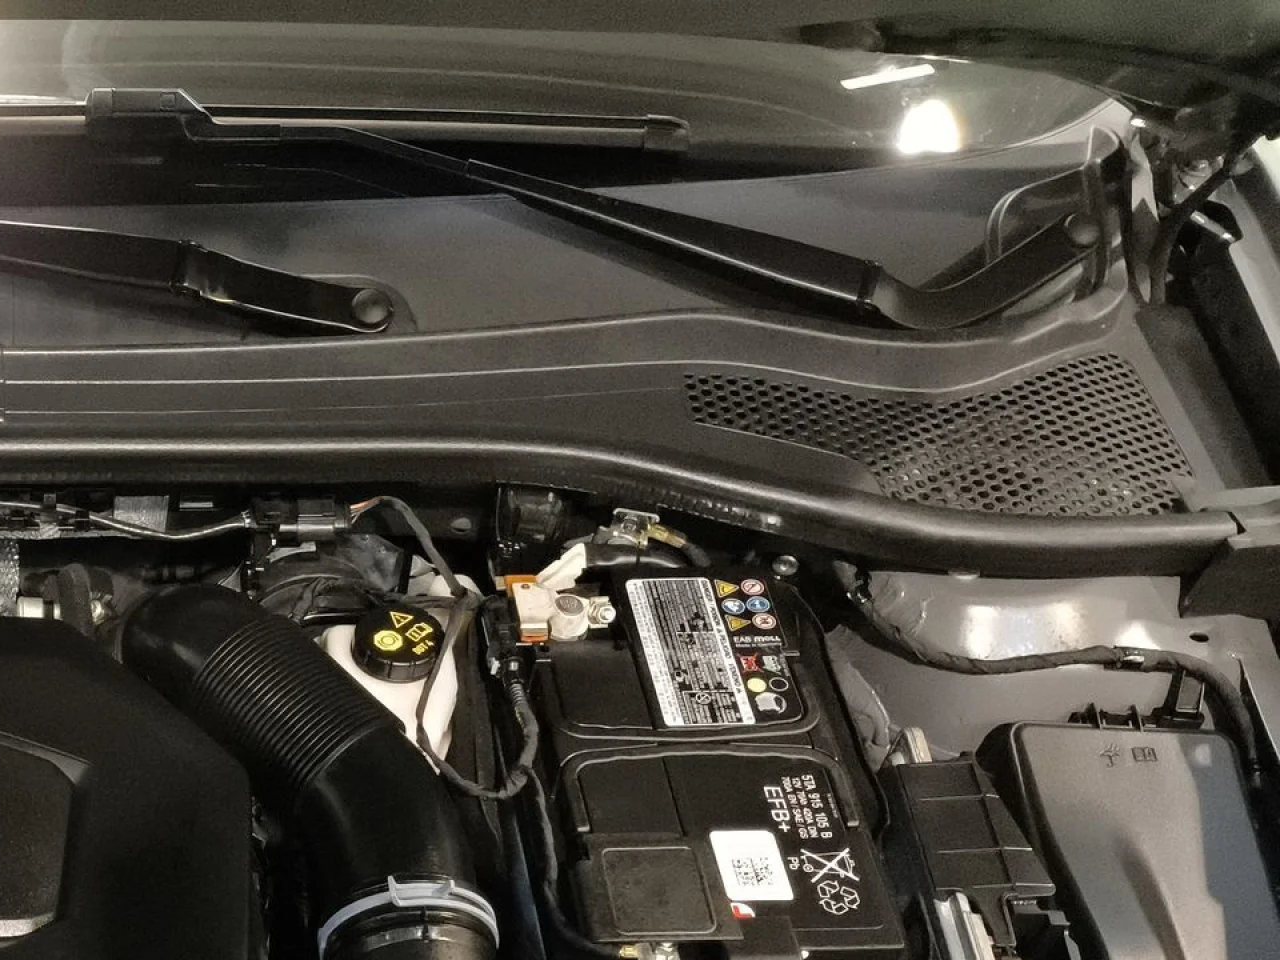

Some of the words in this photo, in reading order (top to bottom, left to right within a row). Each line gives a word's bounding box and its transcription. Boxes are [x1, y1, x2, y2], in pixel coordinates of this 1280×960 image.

[791, 777, 803, 789] 12V
[801, 774, 817, 791] 5TA
[763, 786, 791, 832] EFB+
[807, 792, 824, 809] 915
[815, 812, 830, 829] 105
[820, 831, 833, 839] B
[787, 856, 801, 870] Pb
